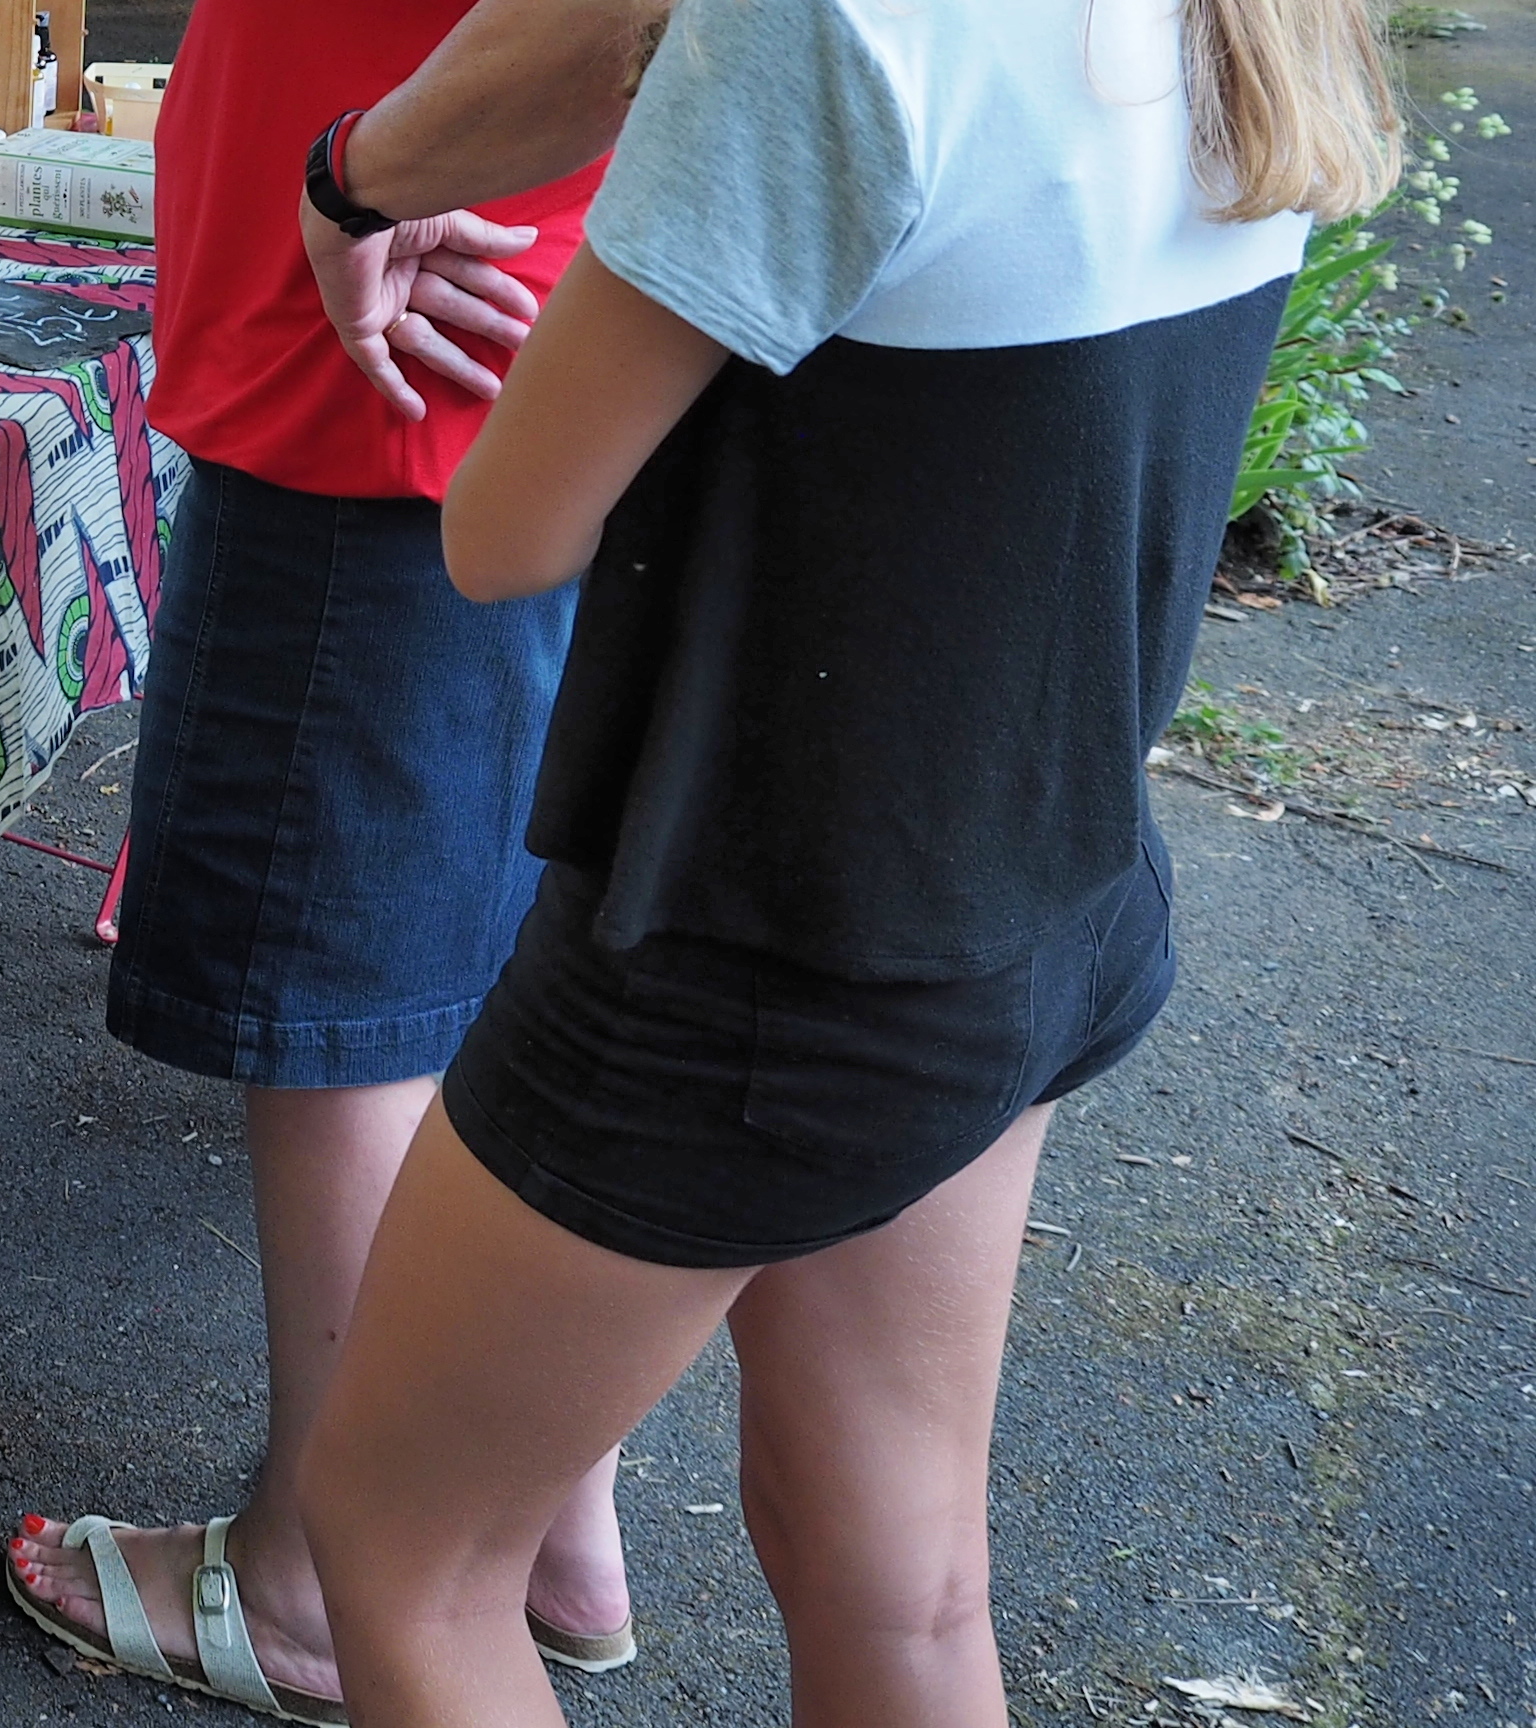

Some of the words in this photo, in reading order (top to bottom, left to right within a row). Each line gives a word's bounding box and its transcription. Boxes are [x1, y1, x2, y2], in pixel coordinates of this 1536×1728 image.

[29, 166, 44, 217] plantes
[42, 185, 52, 201] qui
[52, 169, 63, 220] guérissent
